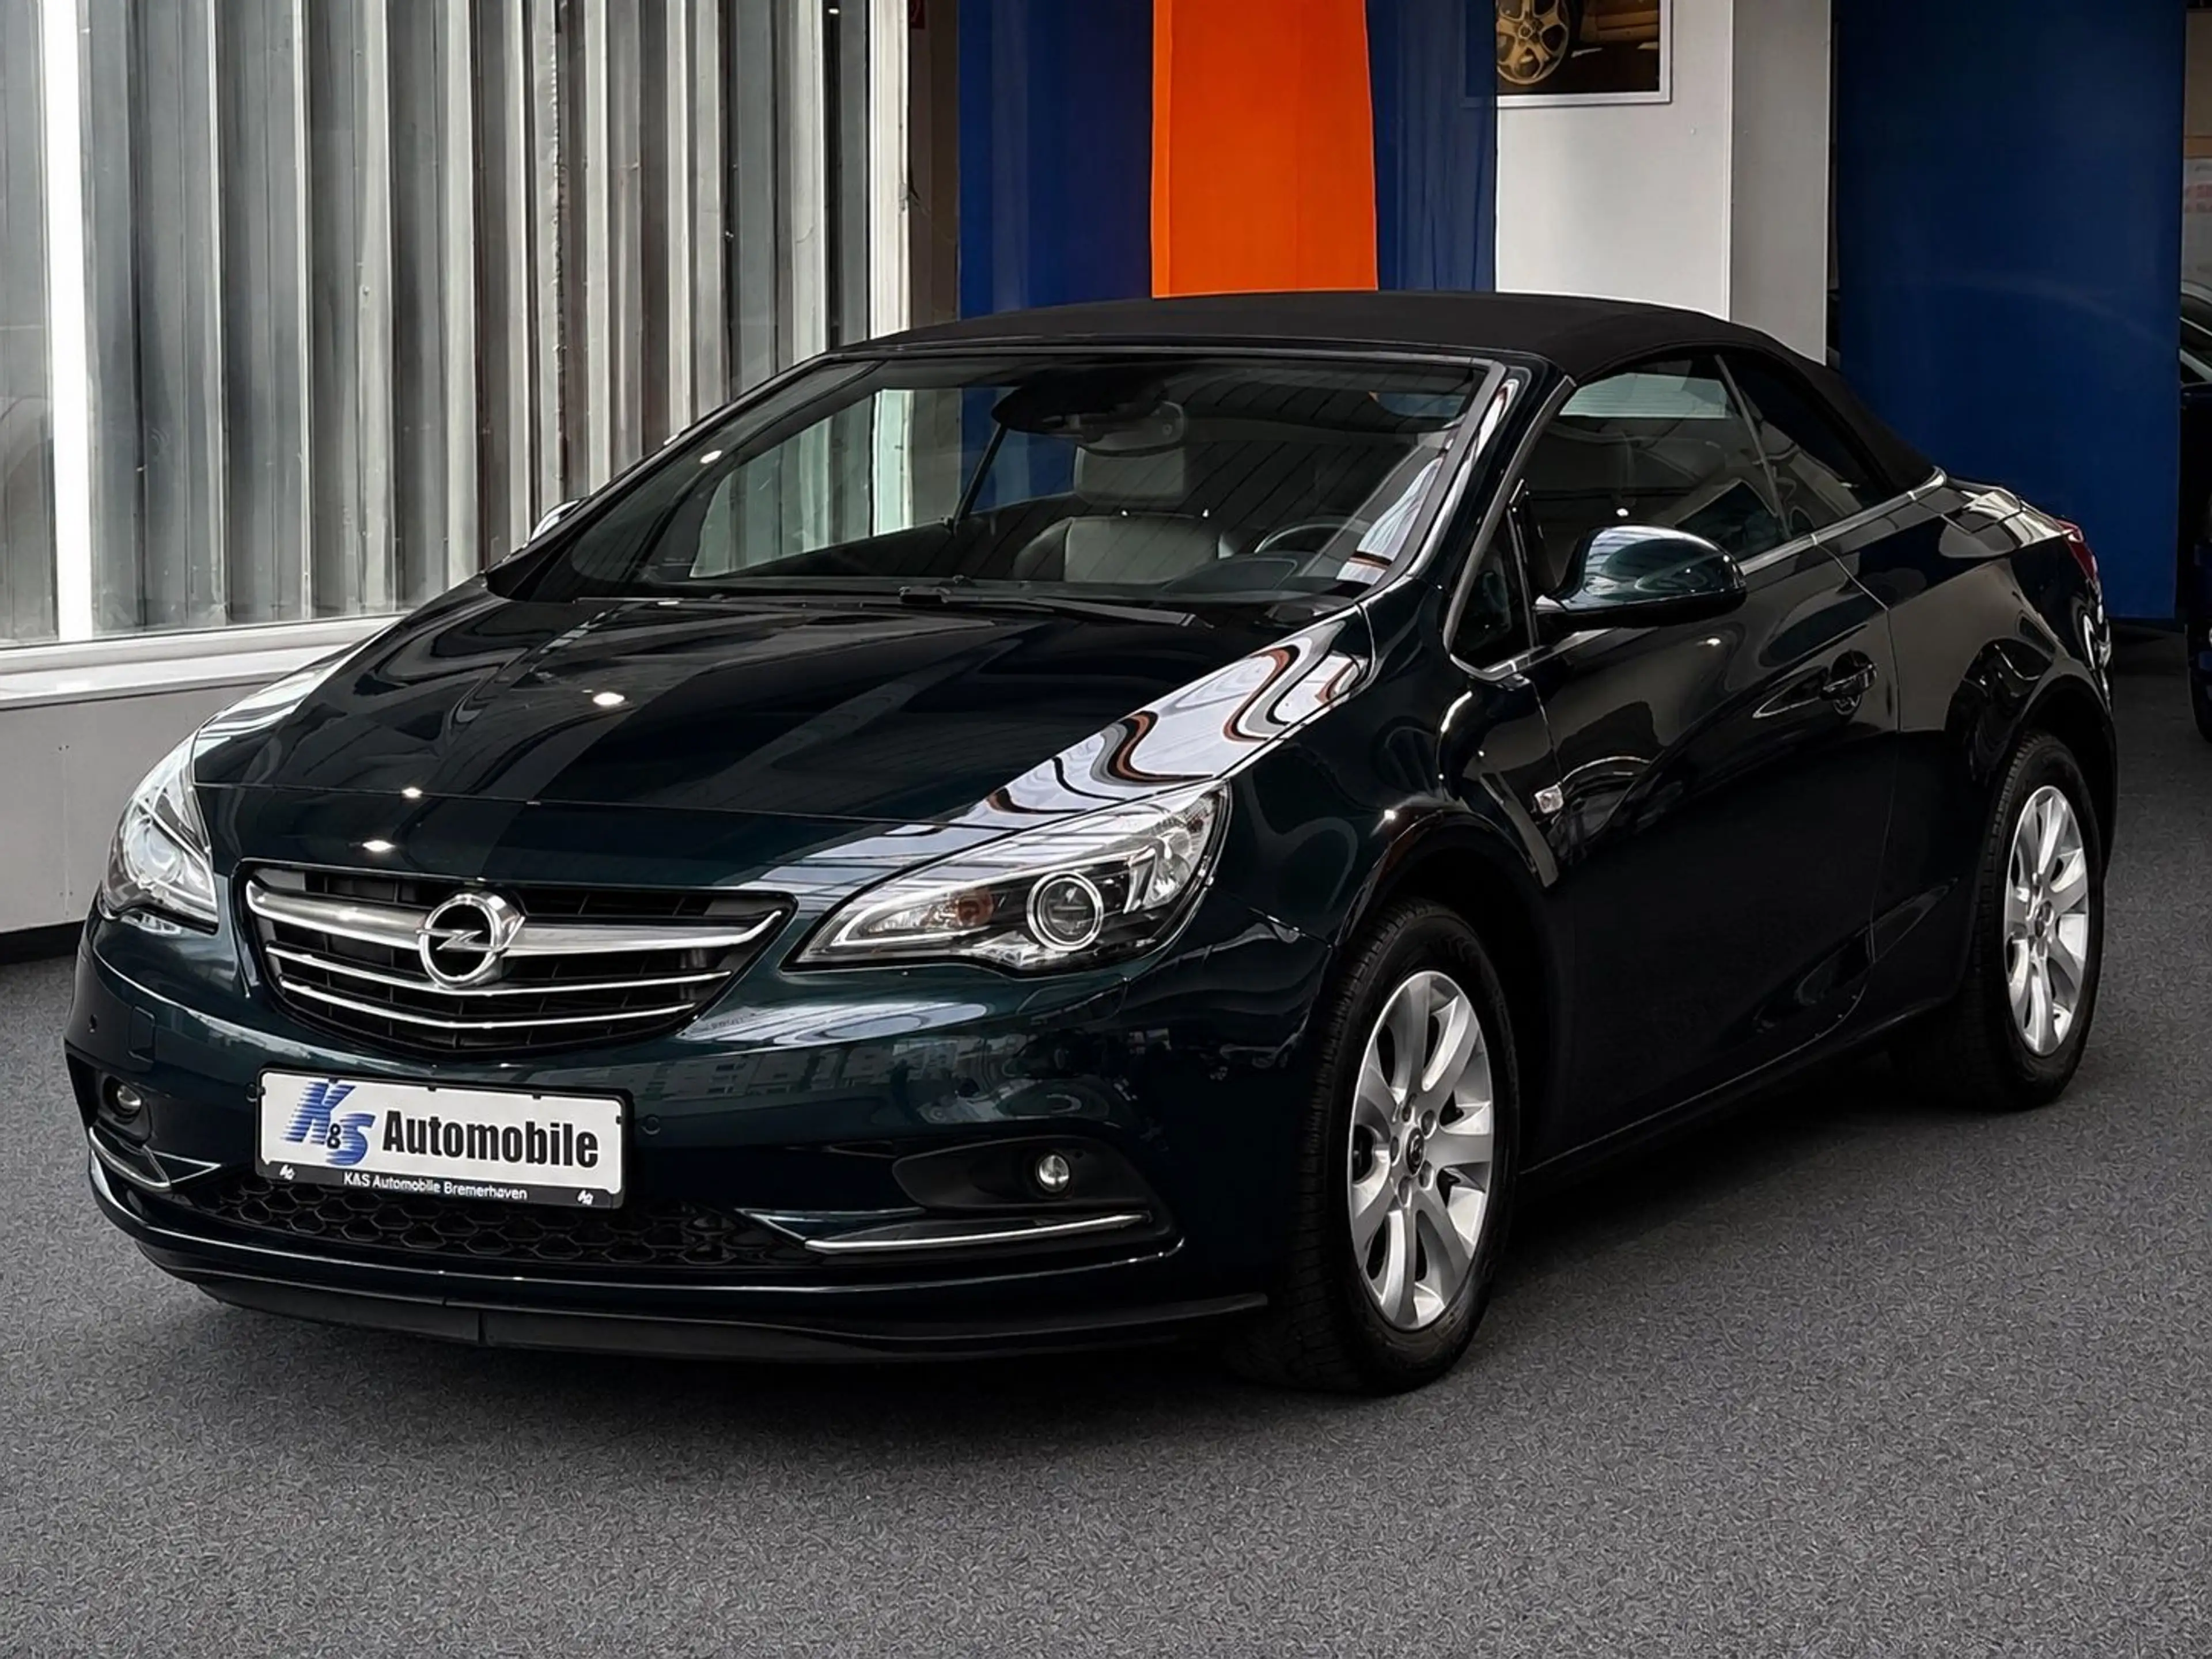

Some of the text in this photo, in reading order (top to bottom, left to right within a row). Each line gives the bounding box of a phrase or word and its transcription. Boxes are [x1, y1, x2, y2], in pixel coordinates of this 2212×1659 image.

[382, 1110, 598, 1168] Automobile
[372, 1175, 441, 1194] Automobile
[444, 1181, 527, 1200] Bremerhaven
